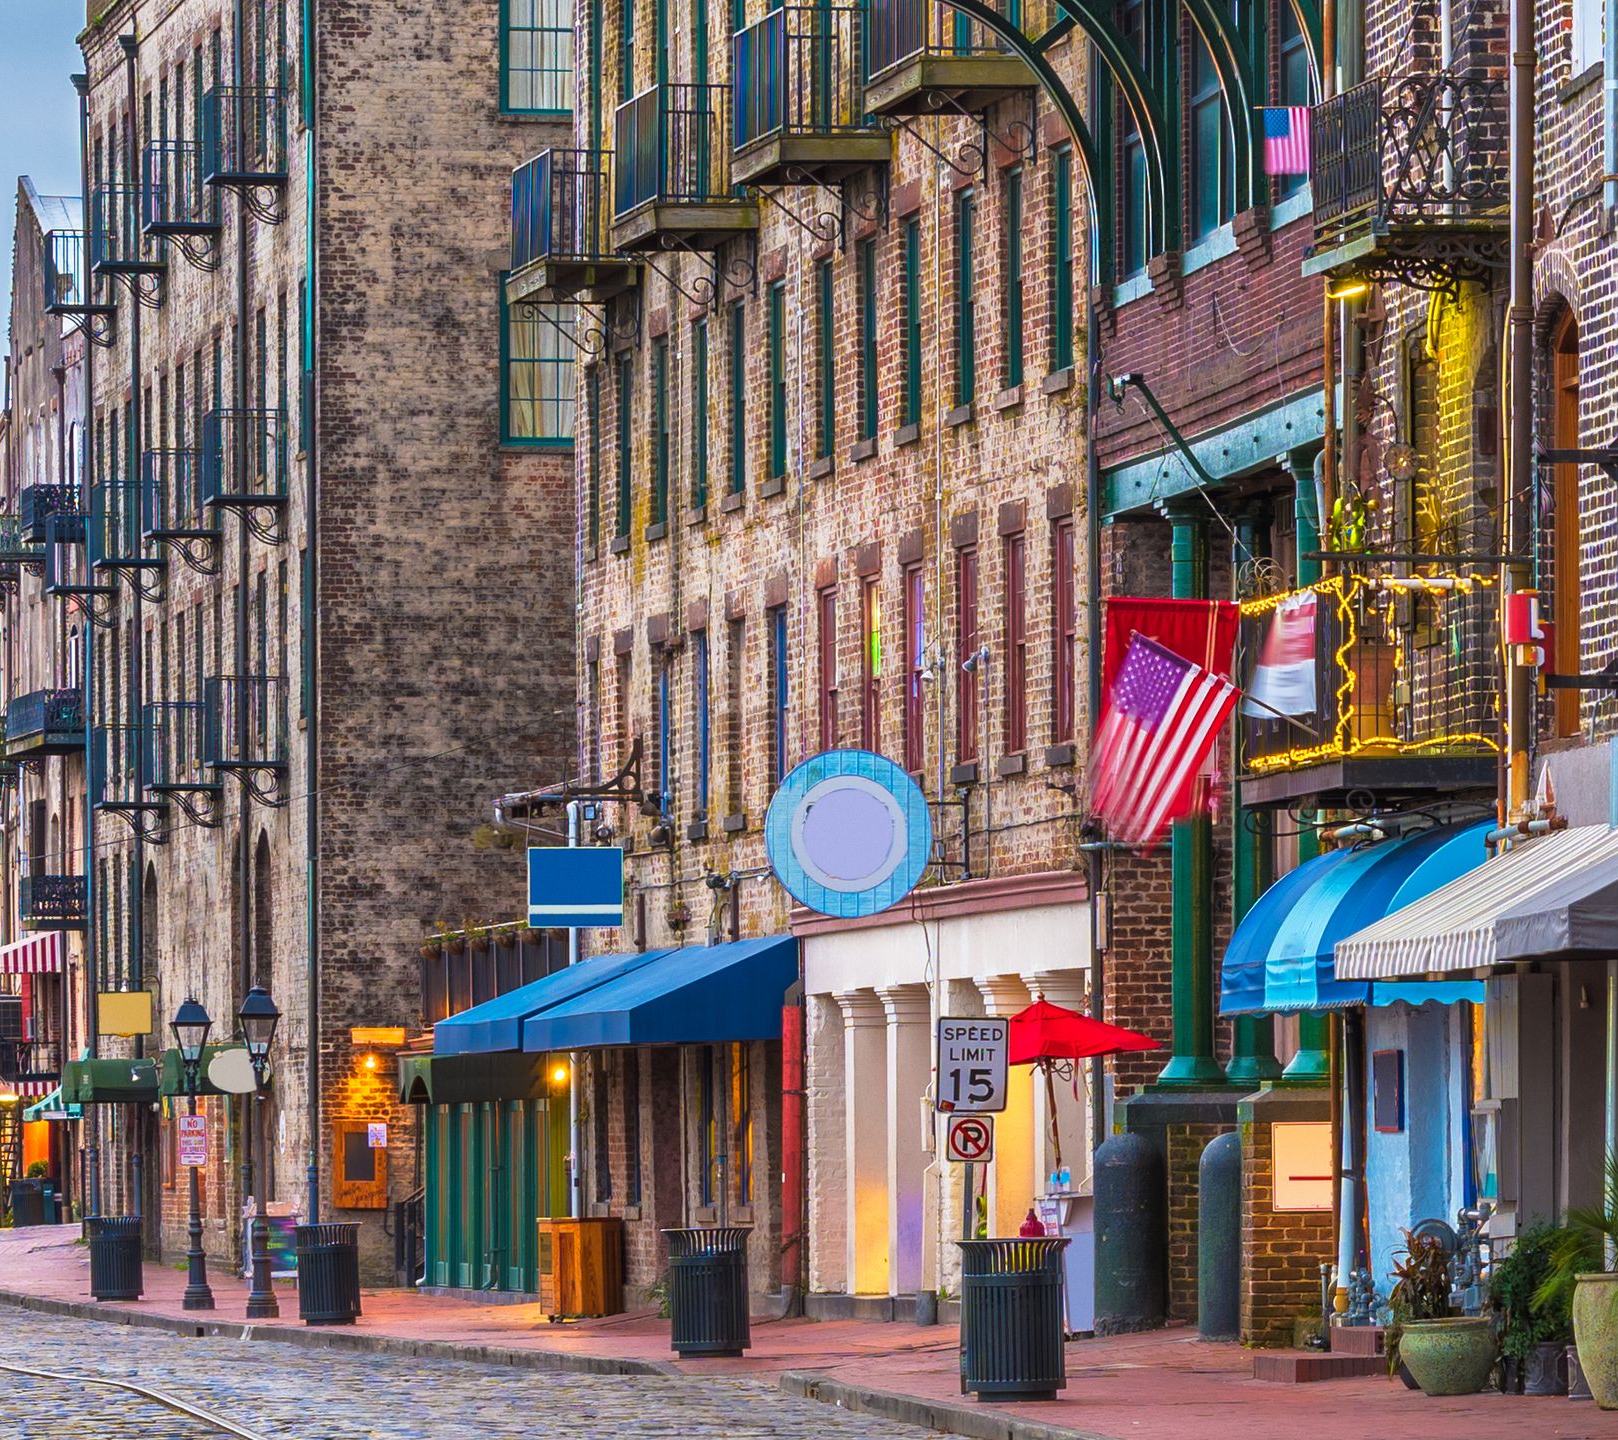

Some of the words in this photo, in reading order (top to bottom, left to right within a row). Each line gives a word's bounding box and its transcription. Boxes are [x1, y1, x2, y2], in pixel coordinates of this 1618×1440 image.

[944, 1027, 1003, 1041] SPEED
[949, 1048, 996, 1061] LIMIT
[949, 1068, 995, 1102] 15
[187, 1120, 198, 1128] NO
